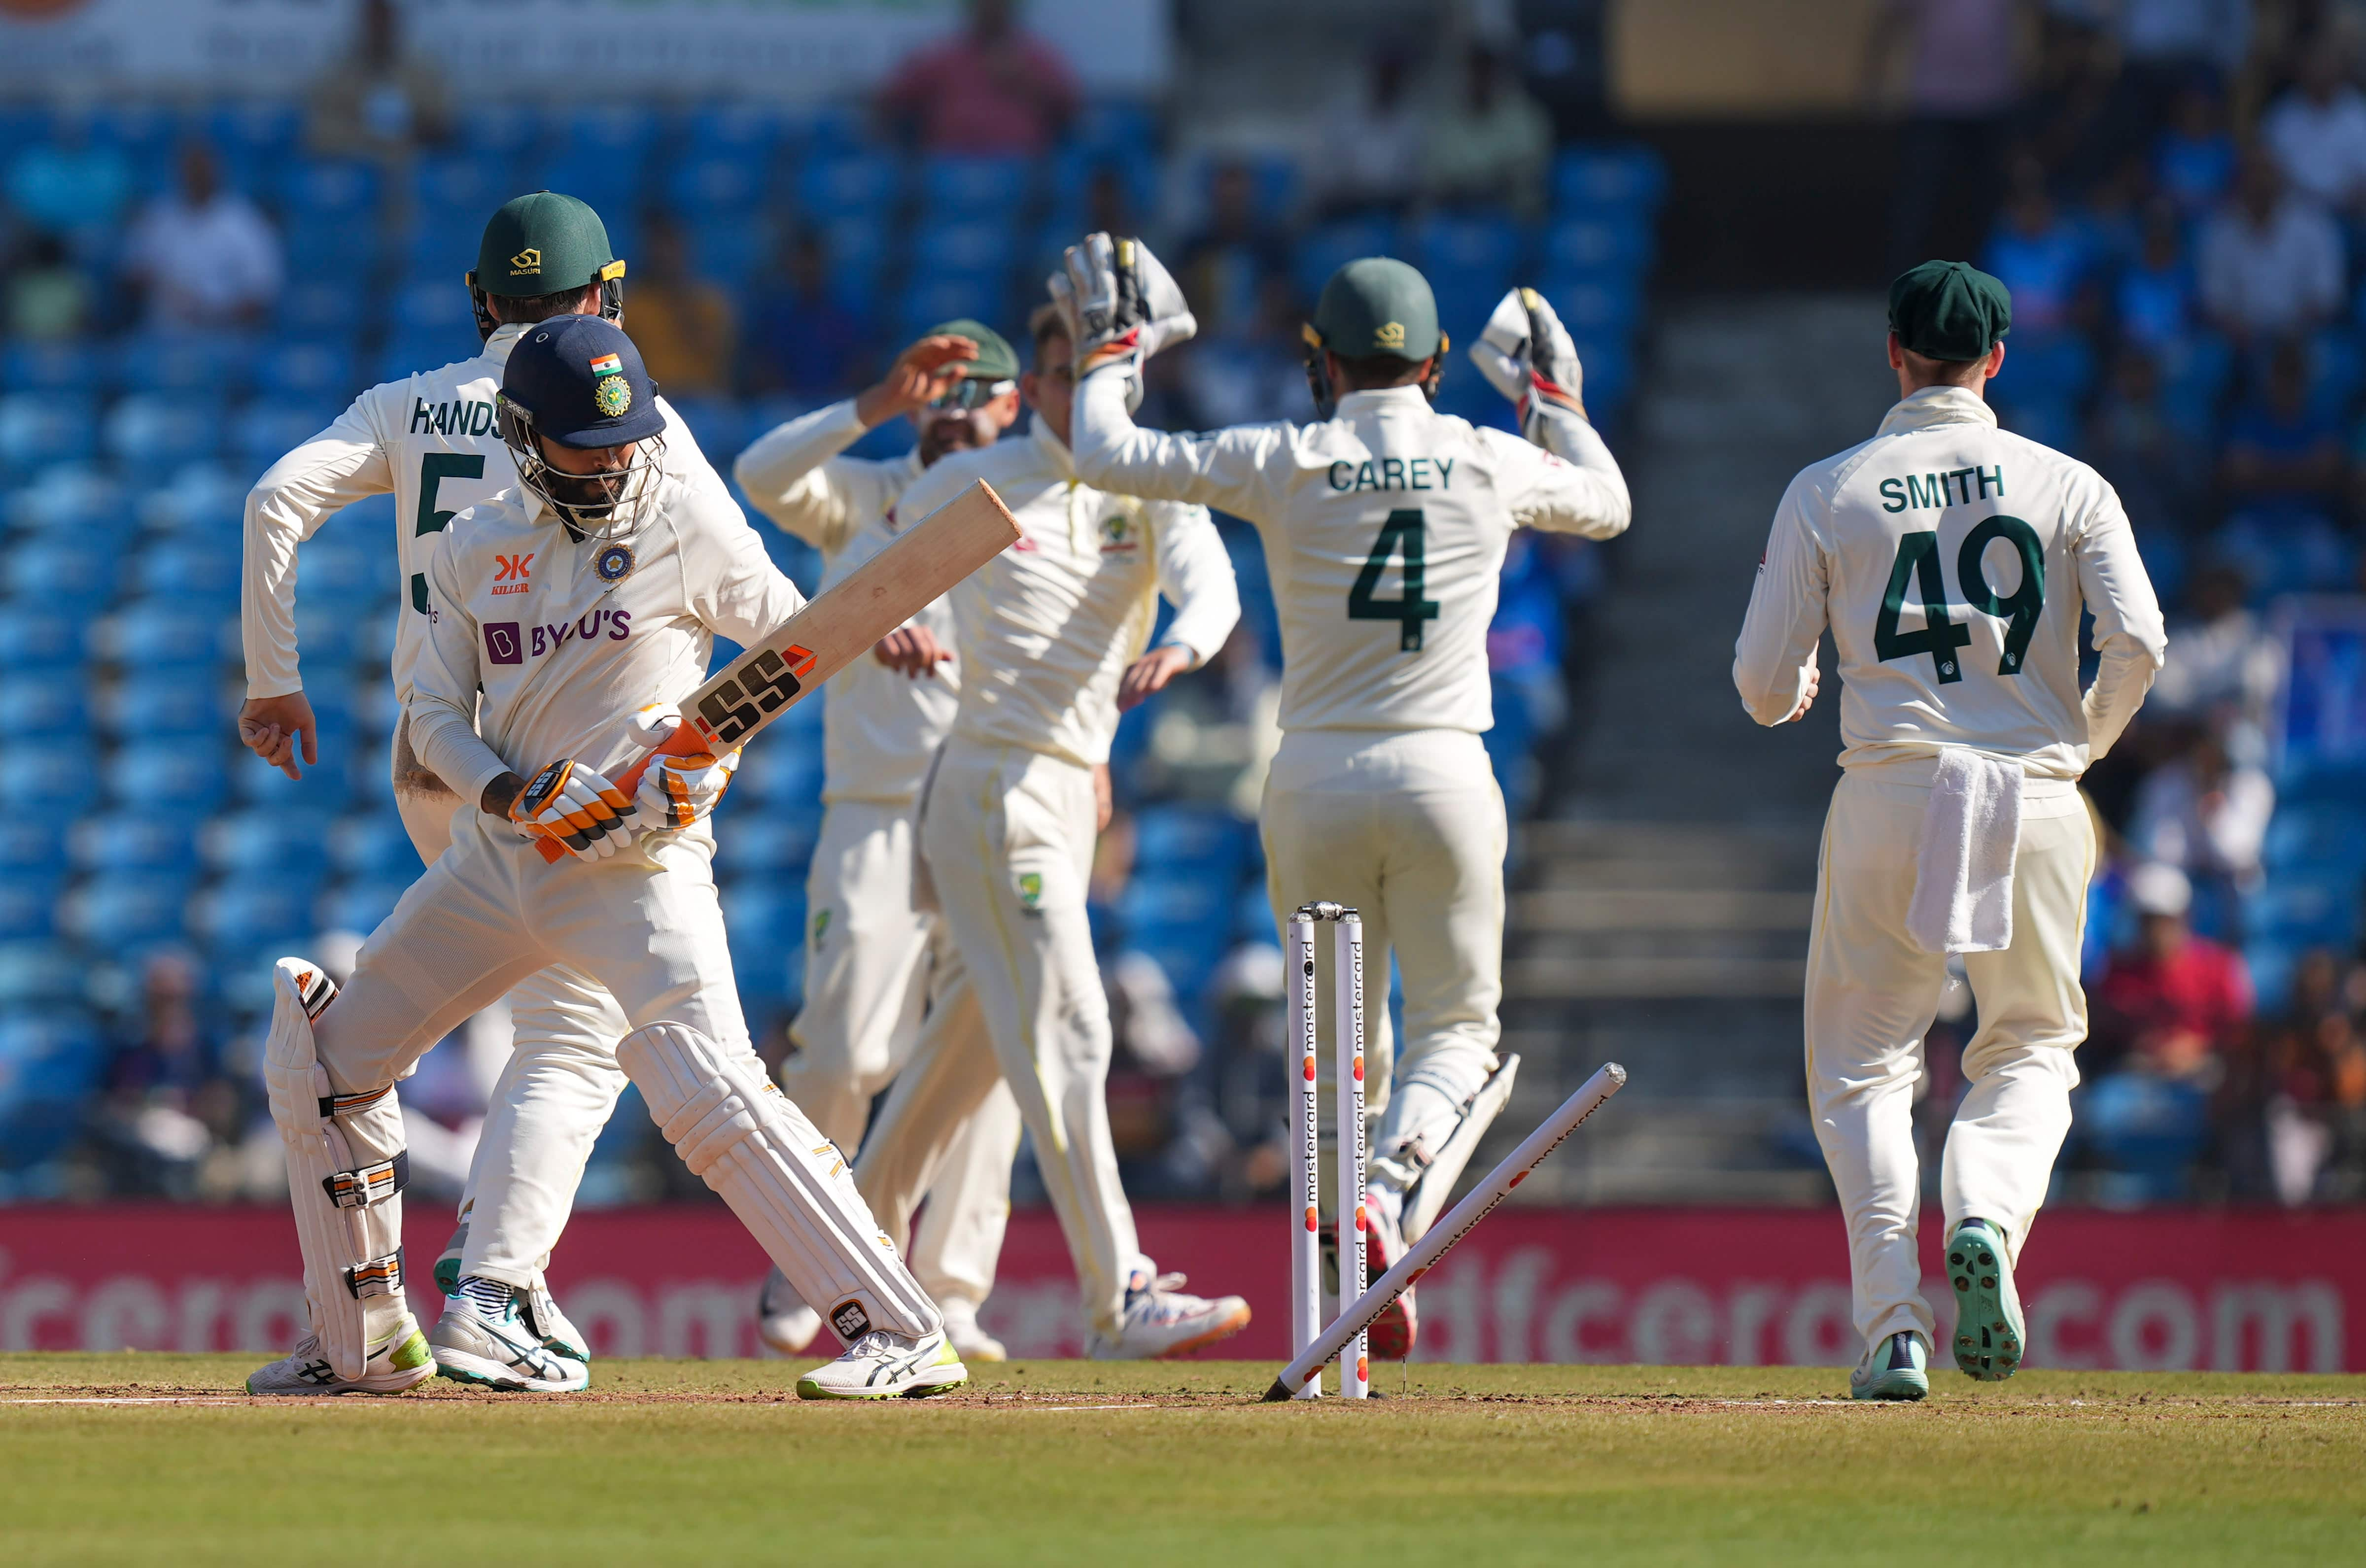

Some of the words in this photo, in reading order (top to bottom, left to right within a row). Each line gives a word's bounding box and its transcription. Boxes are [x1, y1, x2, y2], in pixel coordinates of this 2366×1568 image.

[1329, 458, 1453, 491] CAREY
[1879, 465, 2004, 513] SMITH
[491, 583, 529, 595] KILLER
[1349, 508, 1439, 651] 4
[1874, 515, 2045, 684] 49
[698, 649, 800, 743] SS
[1301, 941, 1314, 1051] mastercrd
[1351, 942, 1363, 1051] mastercard
[1303, 1091, 1316, 1201] mastercard
[1353, 1091, 1365, 1201] mastercard
[1530, 1094, 1609, 1168] mastercard
[1427, 1192, 1506, 1266] mastercard
[835, 1306, 868, 1336] SS
[1324, 1289, 1403, 1364] mastercard
